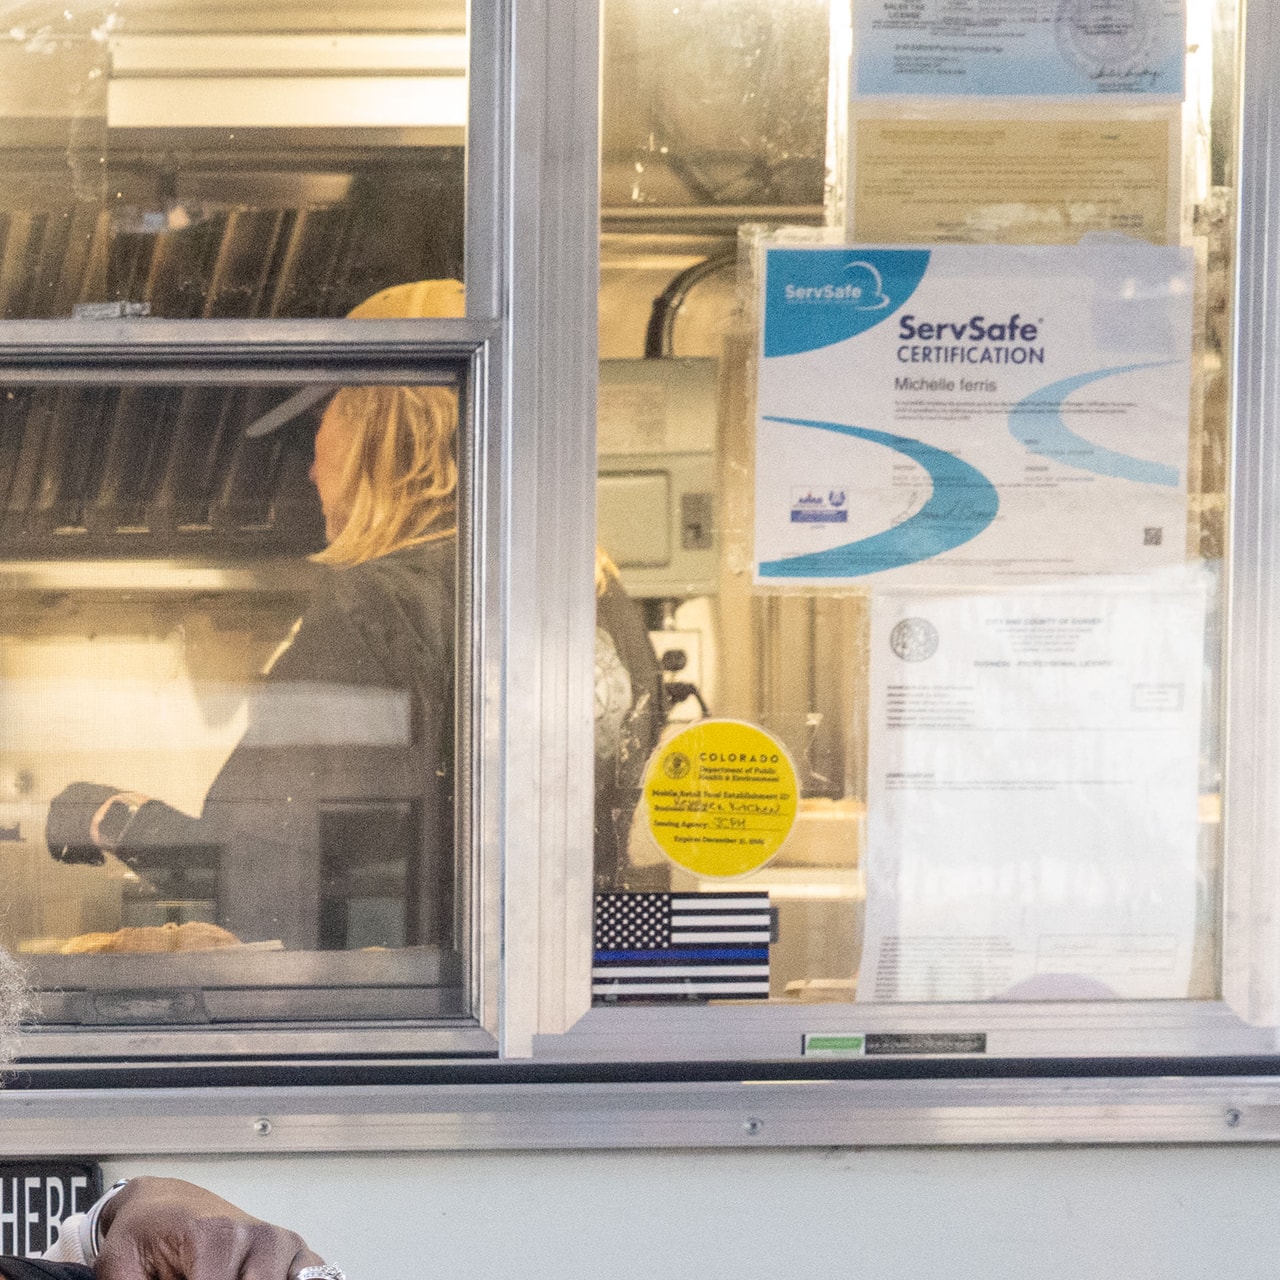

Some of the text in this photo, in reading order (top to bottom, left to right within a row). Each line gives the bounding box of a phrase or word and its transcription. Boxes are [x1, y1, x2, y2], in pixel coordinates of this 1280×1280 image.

[785, 284, 862, 299] ServSafe
[898, 314, 1039, 342] ServSafe
[897, 346, 1045, 364] CERTIFICATION
[894, 377, 997, 393] Michelle ferris
[700, 752, 779, 763] COLORADO
